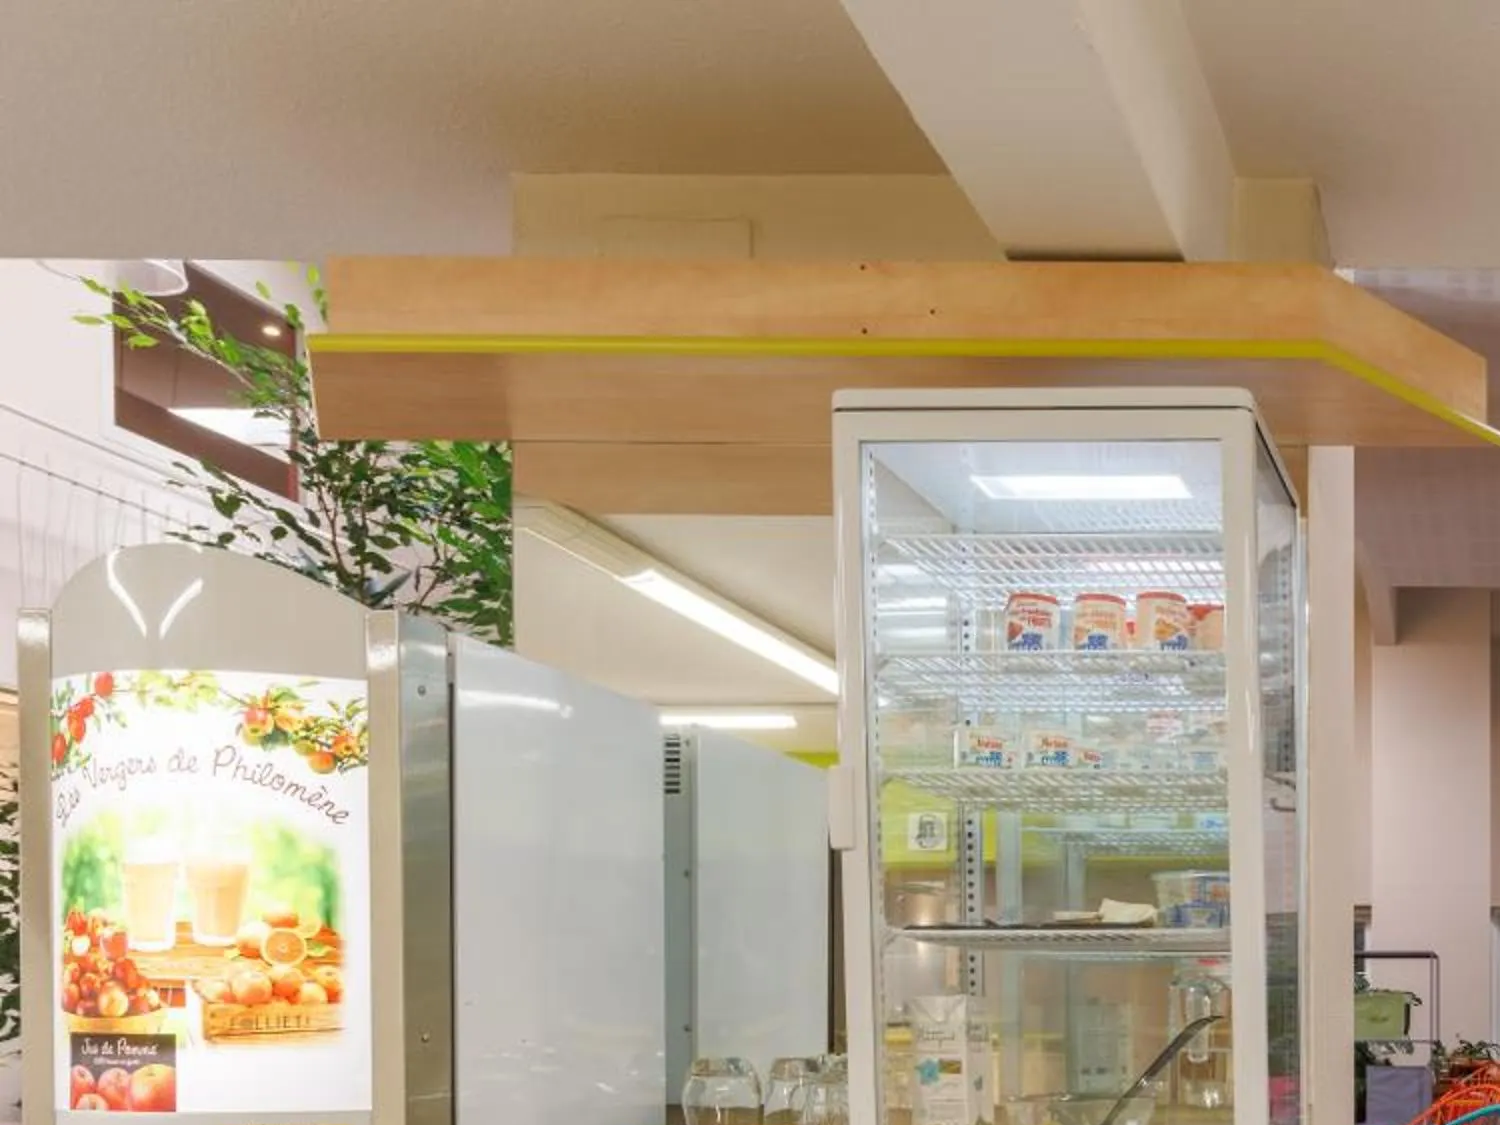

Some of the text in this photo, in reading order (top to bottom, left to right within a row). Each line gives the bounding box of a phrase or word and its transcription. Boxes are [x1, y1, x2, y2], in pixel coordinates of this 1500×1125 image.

[83, 758, 157, 792] Vergers
[167, 747, 199, 774] de
[213, 744, 350, 826] Philomène
